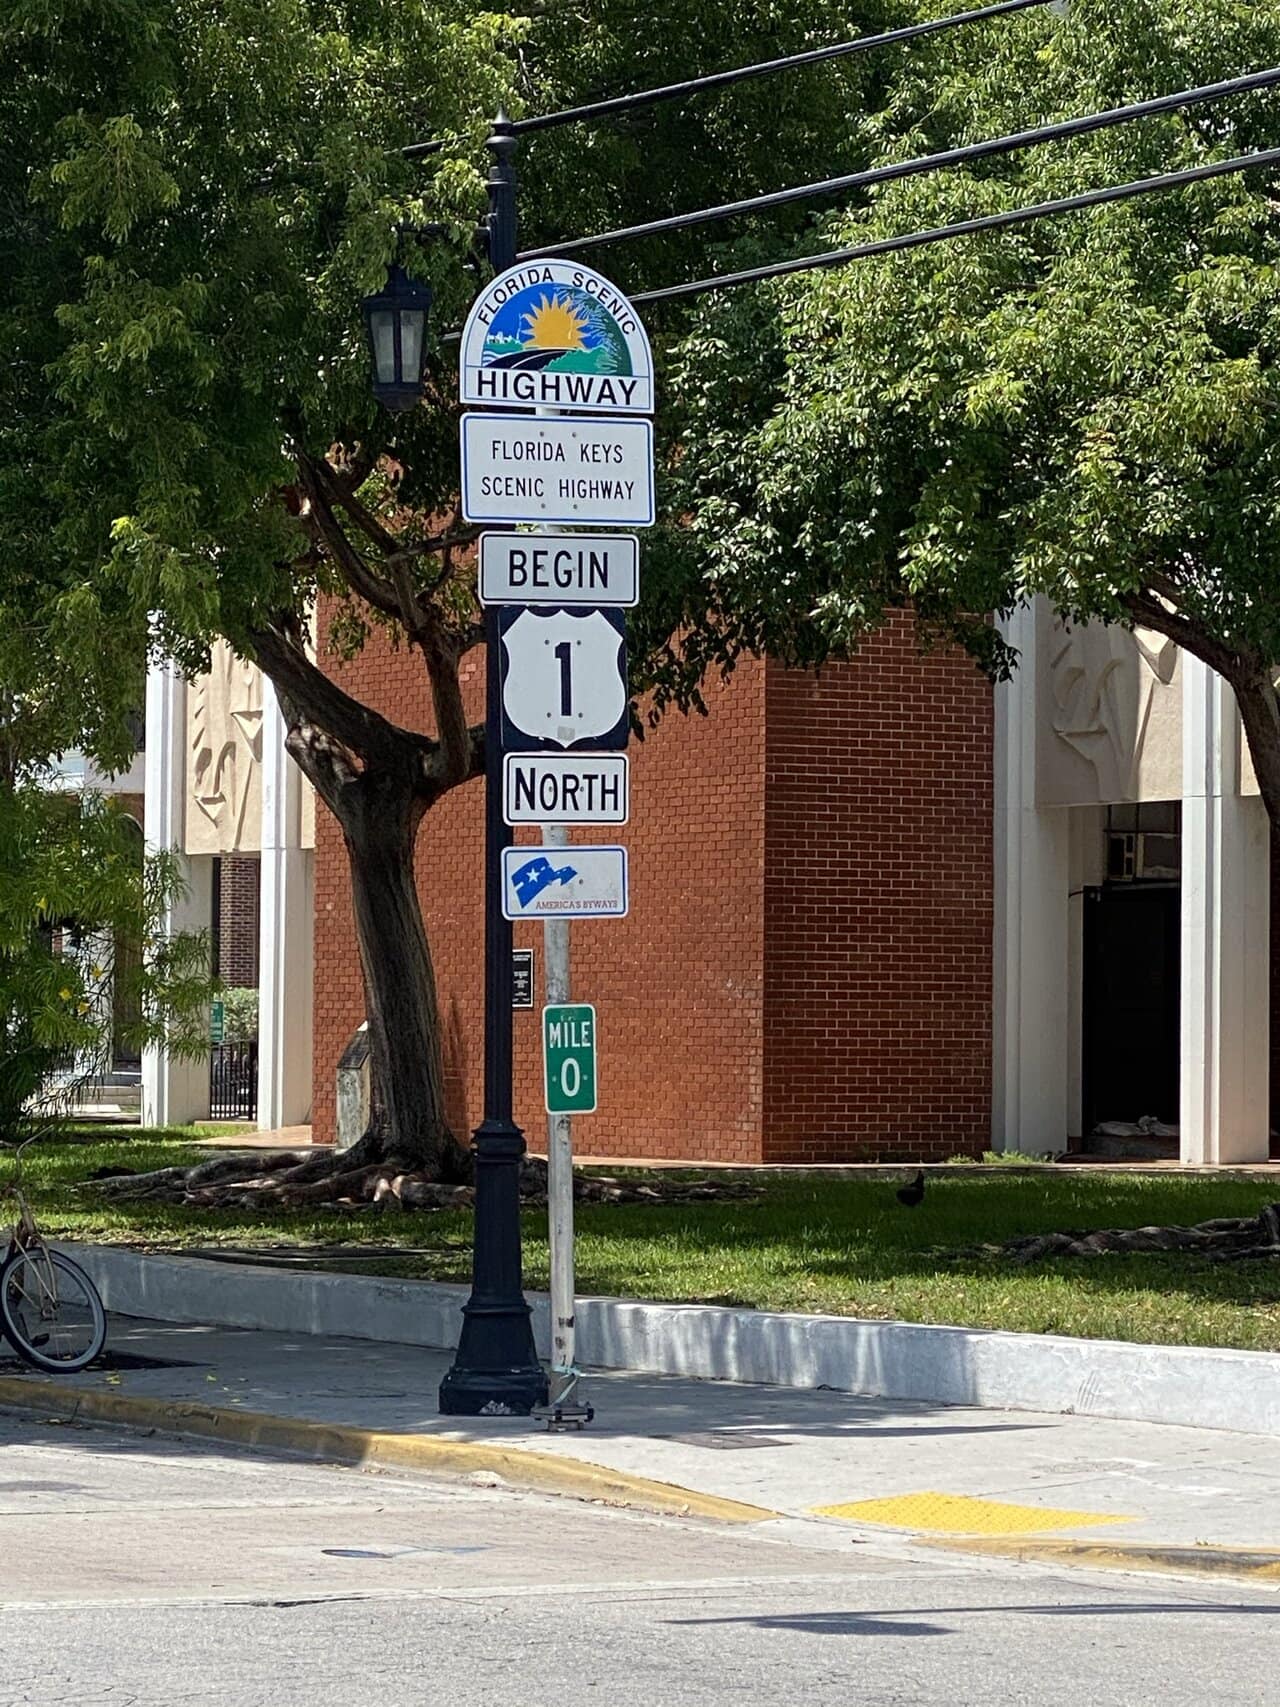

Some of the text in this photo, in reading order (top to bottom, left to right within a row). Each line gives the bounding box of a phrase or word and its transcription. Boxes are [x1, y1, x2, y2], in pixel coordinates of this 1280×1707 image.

[478, 267, 636, 335] FLORIDA SCENIC
[477, 370, 638, 406] HIGHWAY
[491, 440, 623, 463] FLORIDA KEYS
[481, 476, 635, 500] SCENIC HIGHWAY
[509, 549, 609, 589] BEGIN
[554, 641, 572, 716] 1
[514, 767, 619, 811] NORTH
[583, 900, 618, 909] BYWAYS
[549, 1021, 591, 1049] MILE
[560, 1057, 581, 1097] 0
